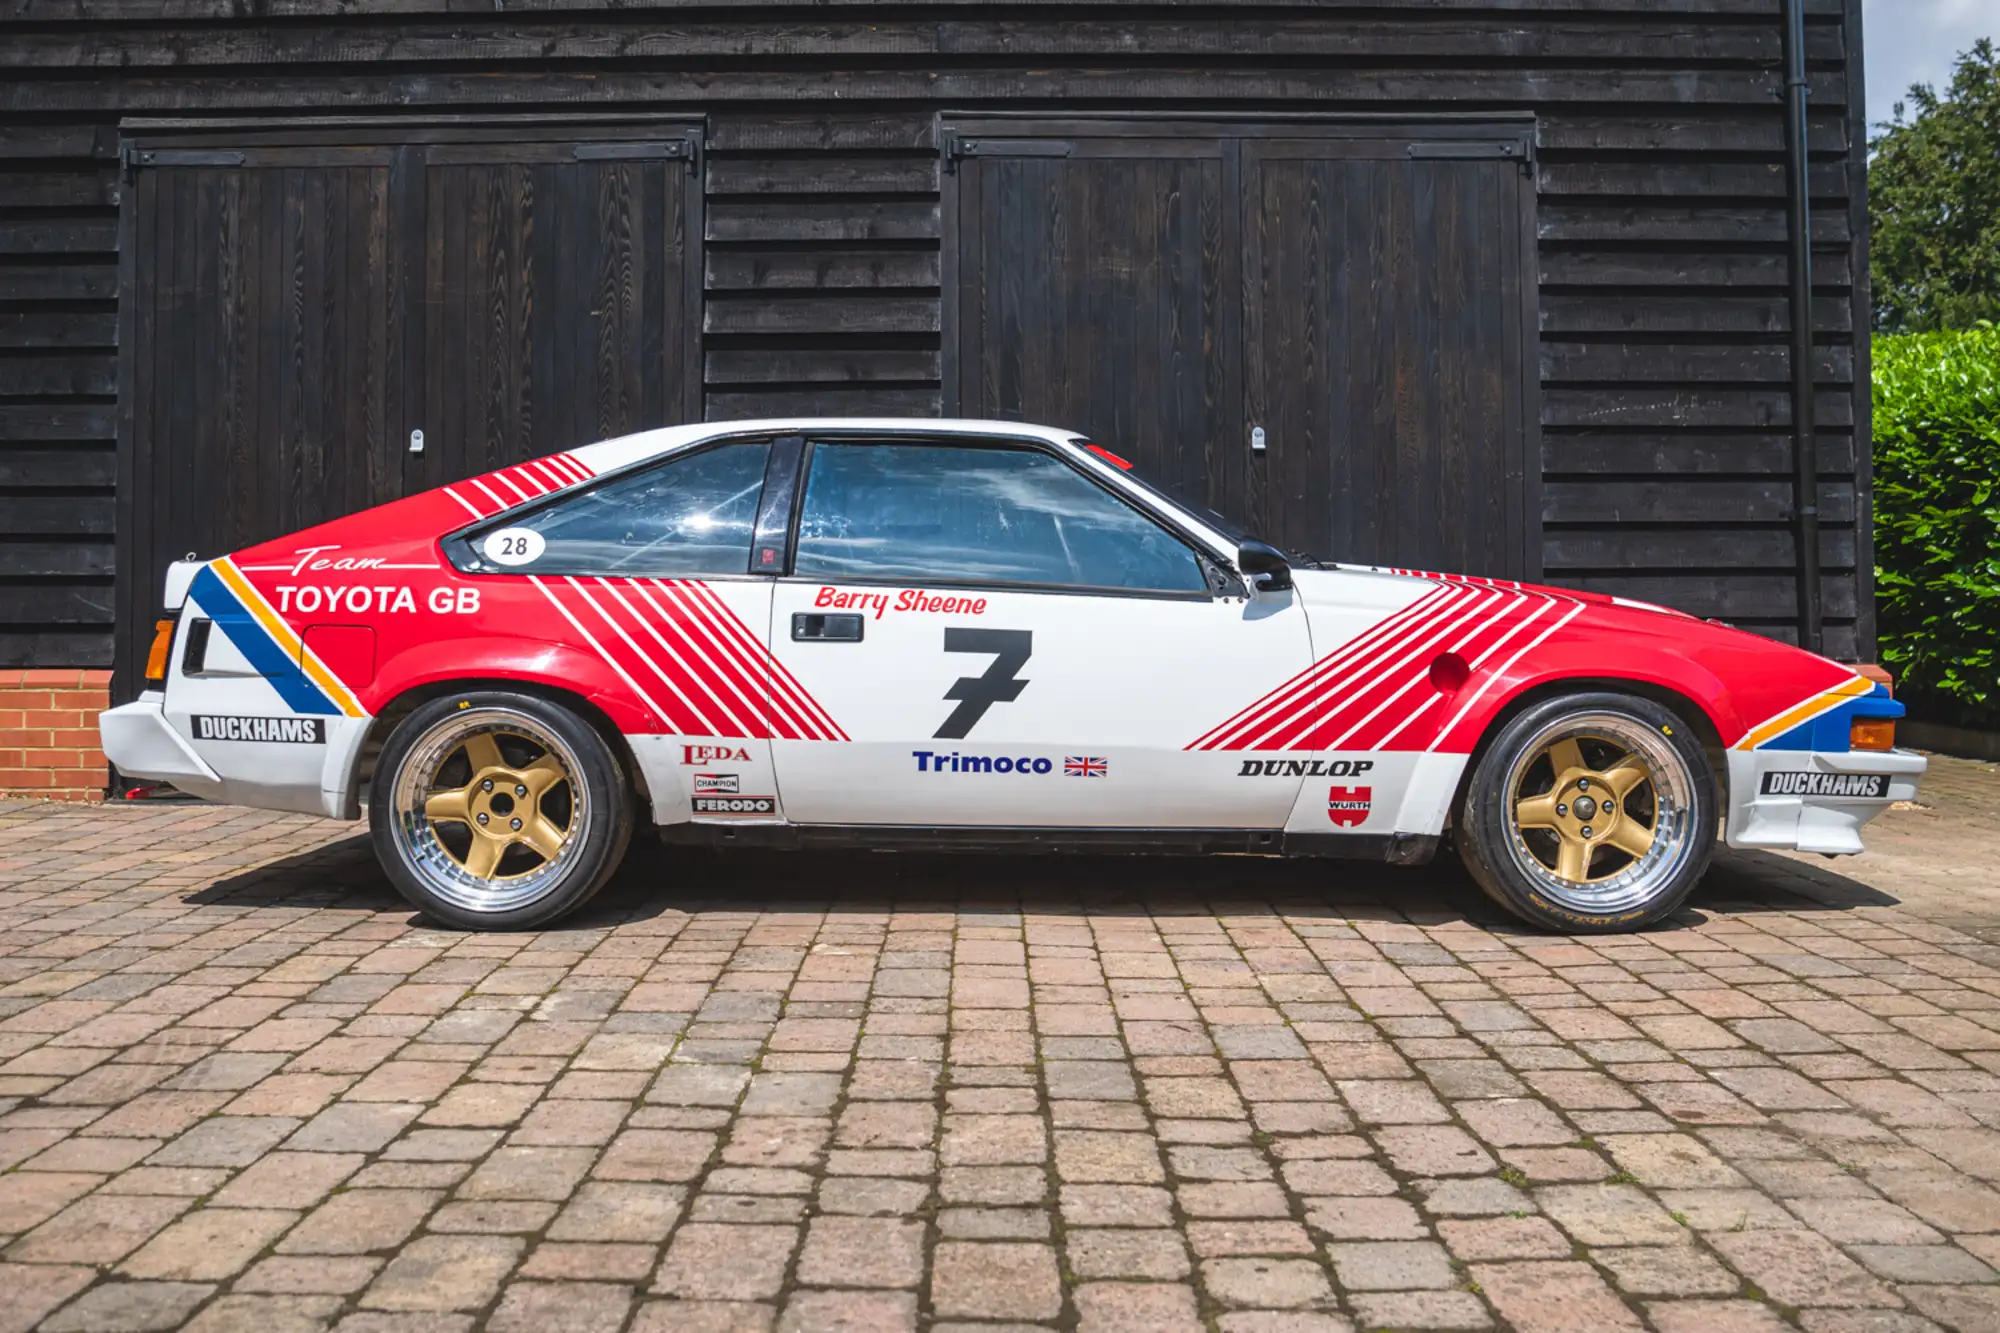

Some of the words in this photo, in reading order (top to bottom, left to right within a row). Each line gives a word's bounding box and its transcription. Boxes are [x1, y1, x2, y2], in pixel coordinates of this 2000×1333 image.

[501, 537, 527, 555] 28
[291, 545, 386, 576] Team
[276, 586, 417, 613] TOYOTA
[428, 587, 481, 614] GB
[815, 587, 889, 620] Barry
[894, 590, 987, 614] Sheene
[932, 627, 1032, 739] 7
[200, 716, 316, 743] DUCKHAMS
[912, 751, 1053, 774] Trimoco
[1237, 760, 1374, 777] DUNLOP
[697, 779, 737, 788] CHAMPION
[1769, 773, 1881, 796] DUCKHAMS
[697, 800, 770, 811] FERODO
